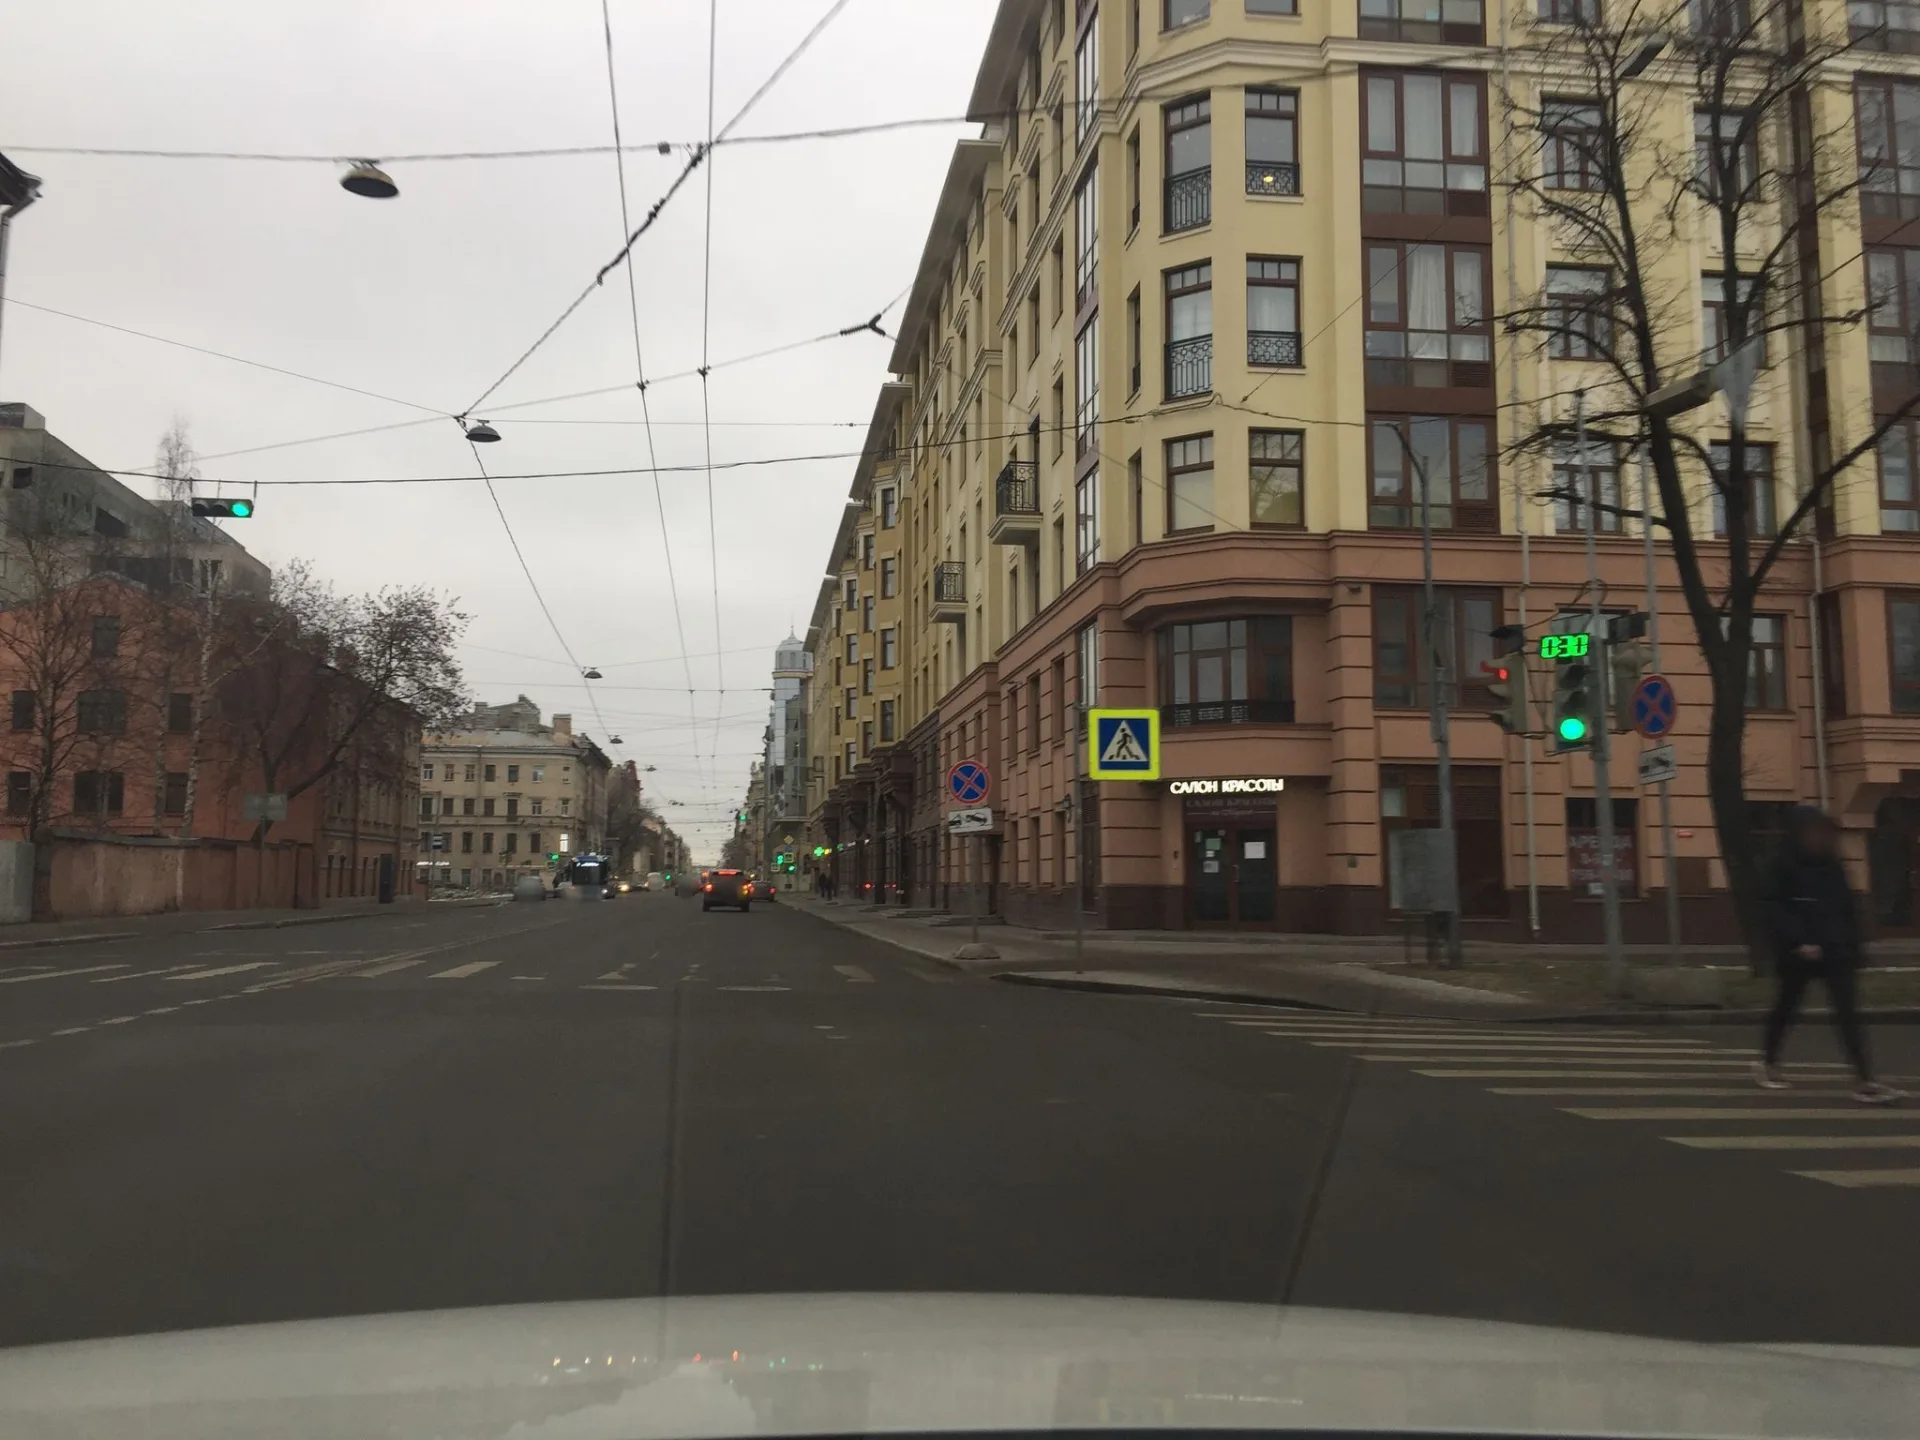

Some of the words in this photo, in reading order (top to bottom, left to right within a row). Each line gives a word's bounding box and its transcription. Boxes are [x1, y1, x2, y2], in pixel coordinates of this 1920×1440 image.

[1170, 780, 1218, 794] САЛОН
[1222, 779, 1284, 793] КРАСОТЫ
[1569, 835, 1632, 849] АРЕДА
